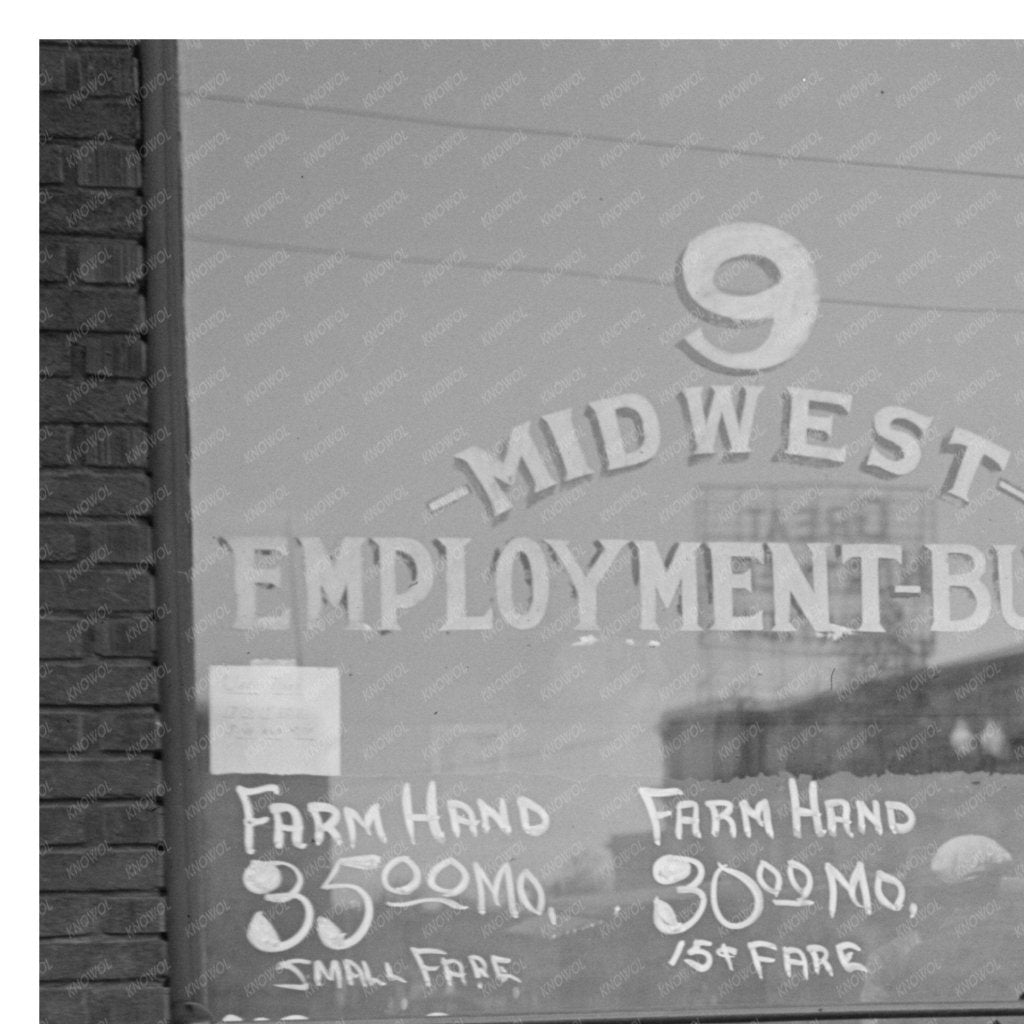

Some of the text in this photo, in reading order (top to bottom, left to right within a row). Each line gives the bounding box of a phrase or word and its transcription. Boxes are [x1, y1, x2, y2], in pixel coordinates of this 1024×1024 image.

[675, 221, 821, 376] 9
[235, 780, 550, 855] FARM HAND
[638, 777, 917, 846] FARM HAND
[272, 946, 523, 991] SMALL FARE
[747, 940, 868, 981] FARE
